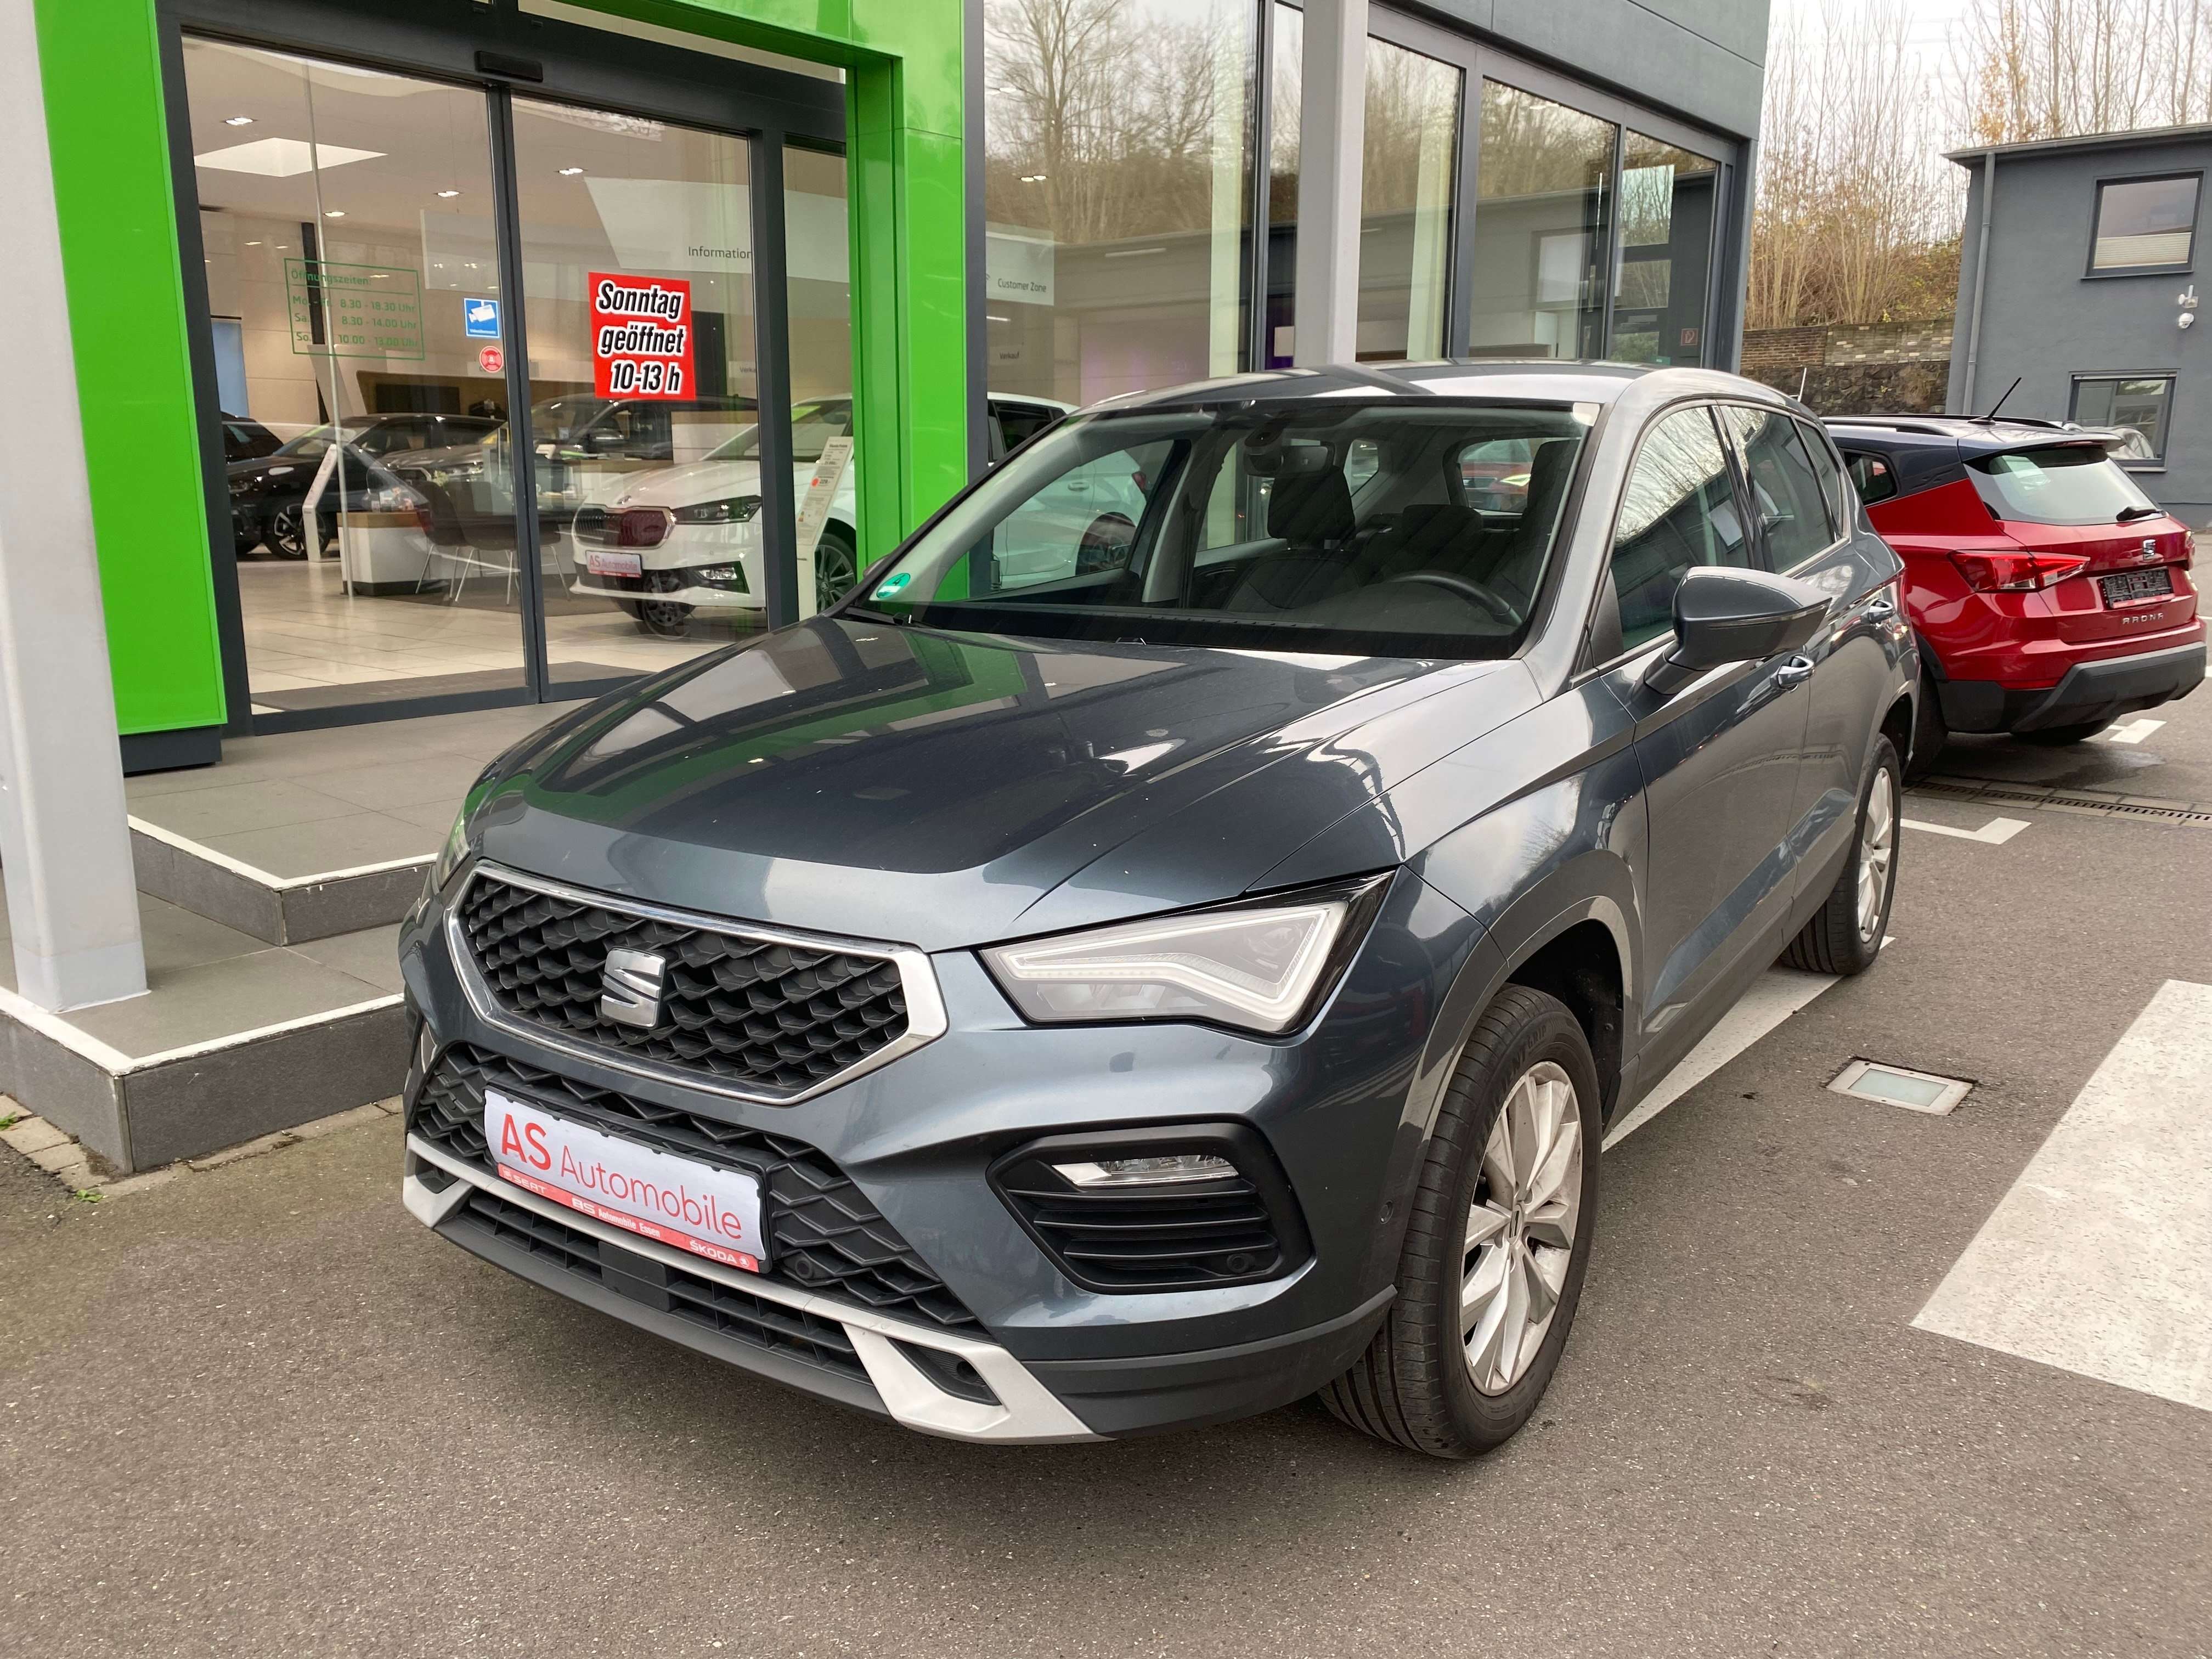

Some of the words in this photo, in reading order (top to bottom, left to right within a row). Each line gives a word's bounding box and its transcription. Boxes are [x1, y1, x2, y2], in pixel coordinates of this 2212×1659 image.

[997, 278, 1029, 290] Customer
[1030, 282, 1047, 293] Zone
[340, 298, 361, 308] 8.30
[371, 301, 396, 311] 18.30
[398, 303, 415, 312] Uhr
[598, 281, 682, 320] Sonntag
[342, 316, 363, 325] 8.30
[371, 318, 397, 328] 14.00
[400, 320, 416, 329] Uhr
[338, 335, 365, 345] 10.00
[374, 337, 399, 346] 13.00
[402, 338, 418, 347] Uhr
[600, 324, 684, 355] geöffnet
[612, 363, 662, 391] 10-13
[667, 365, 680, 391] h
[589, 555, 601, 567] AS
[893, 574, 906, 586] 4
[2122, 612, 2164, 625] ARONA
[501, 1113, 551, 1171] AS
[560, 1145, 742, 1239] Automobile
[512, 1174, 548, 1194] SEAT
[597, 1208, 637, 1230] Automobile
[639, 1221, 661, 1238] Essen
[689, 1239, 738, 1265] ŠKODA
